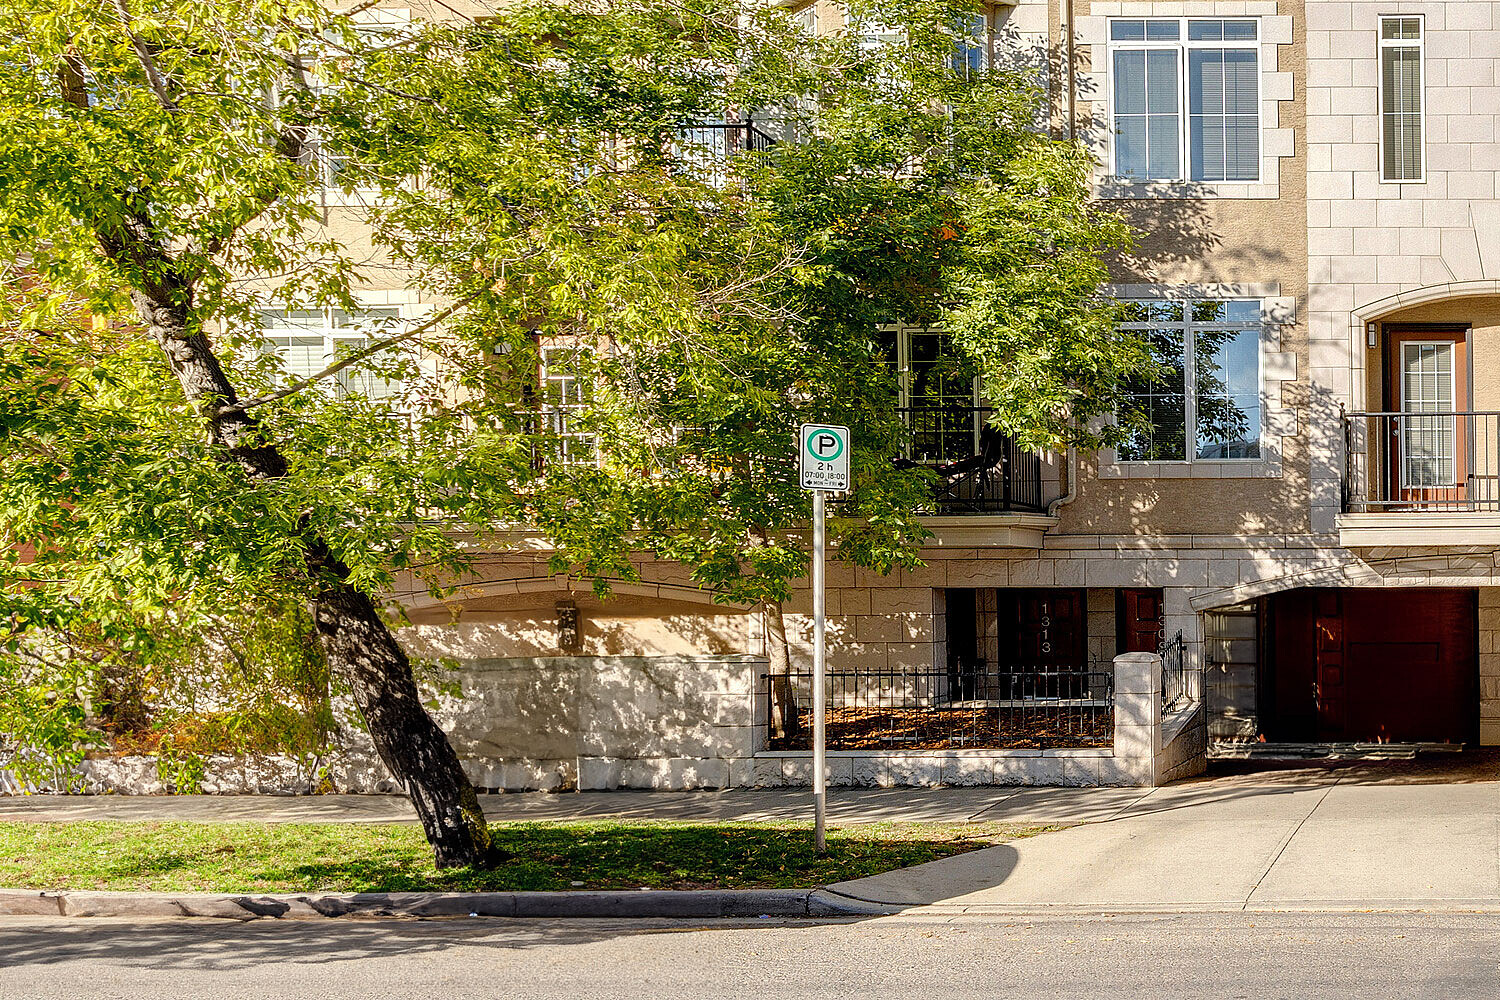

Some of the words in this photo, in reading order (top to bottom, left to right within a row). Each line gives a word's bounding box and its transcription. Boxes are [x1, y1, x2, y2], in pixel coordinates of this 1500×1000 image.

[818, 435, 836, 454] P
[817, 462, 824, 471] 2
[827, 463, 833, 471] h
[805, 471, 825, 479] 07:00
[827, 472, 845, 480] 18:00
[1041, 602, 1051, 653] 1313
